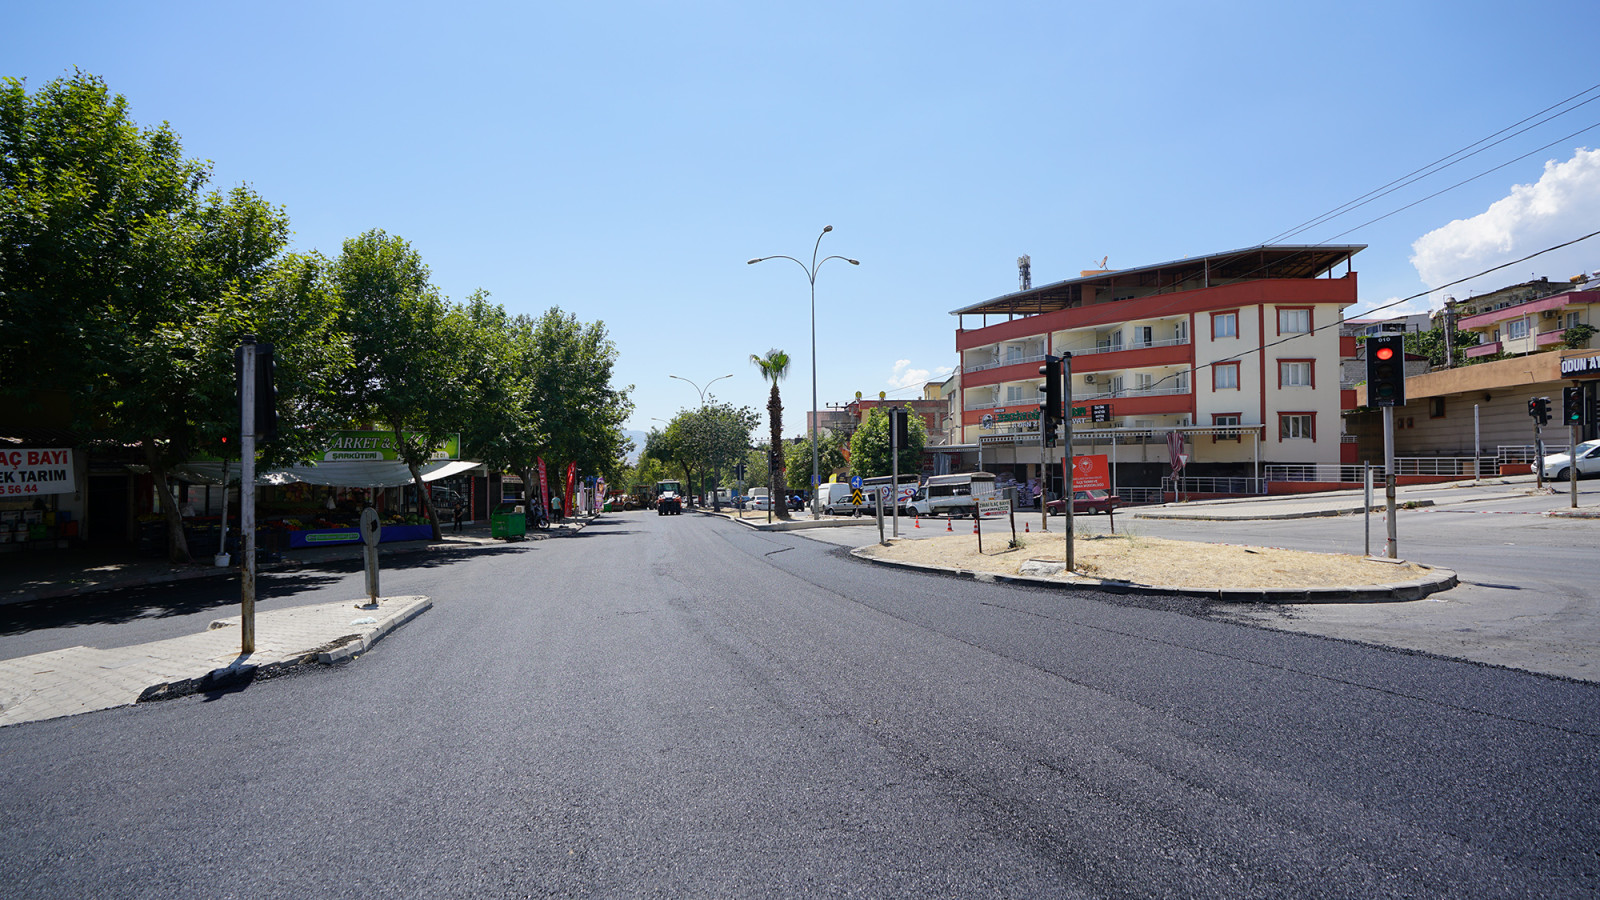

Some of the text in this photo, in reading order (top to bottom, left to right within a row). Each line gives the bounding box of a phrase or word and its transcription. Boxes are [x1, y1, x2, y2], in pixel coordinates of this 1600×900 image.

[1561, 358, 1588, 373] ODUN
[381, 438, 391, 449] &
[27, 451, 68, 467] BAYİ
[19, 470, 67, 482] TARIM
[8, 485, 22, 494] 56
[24, 484, 38, 493] 44
